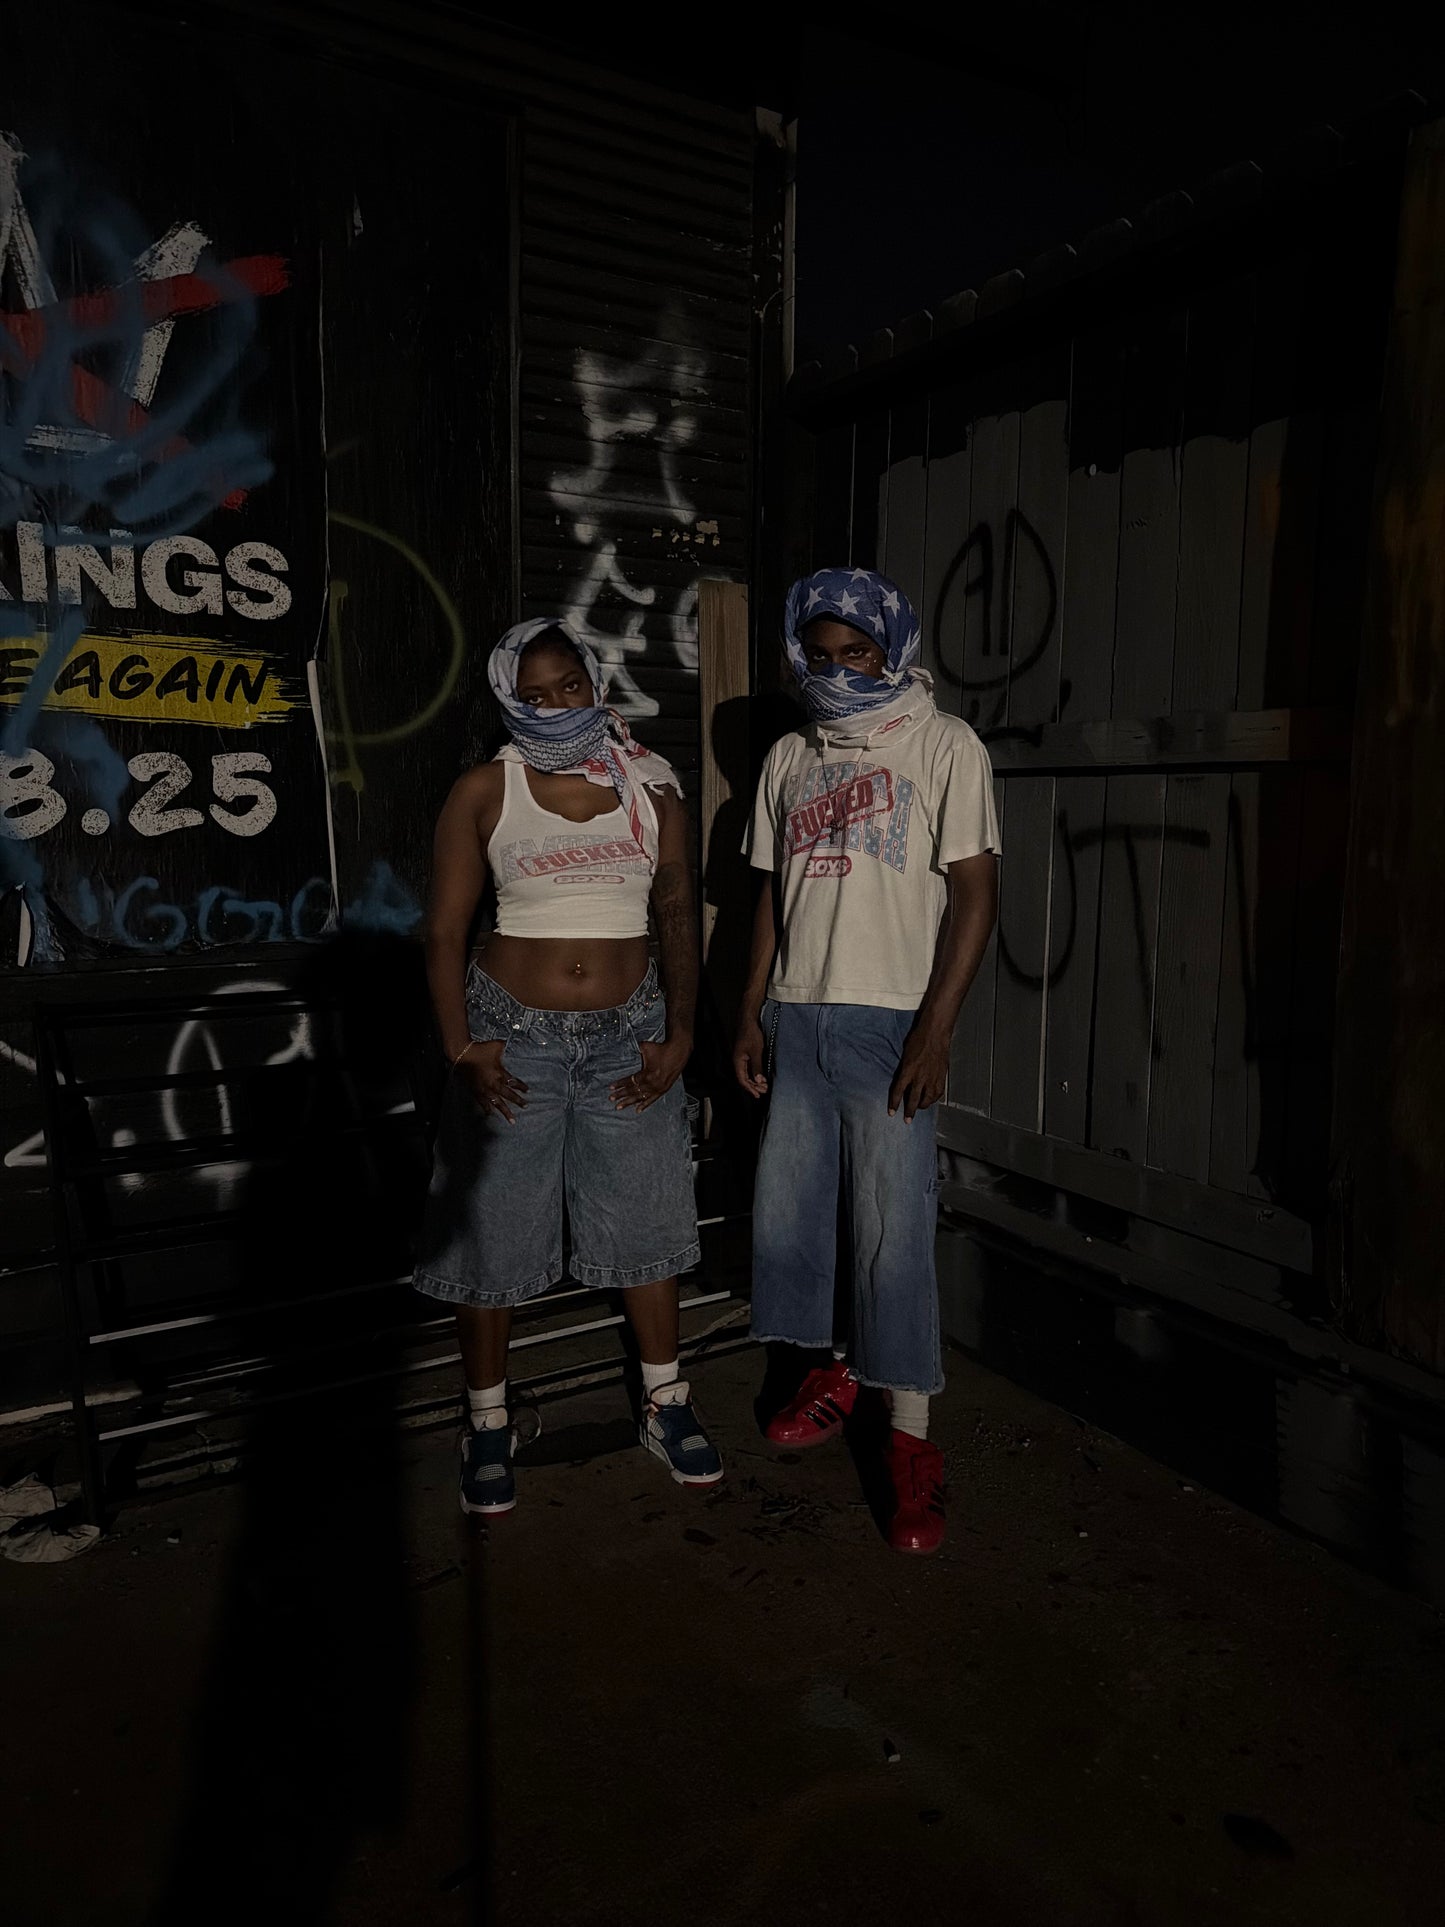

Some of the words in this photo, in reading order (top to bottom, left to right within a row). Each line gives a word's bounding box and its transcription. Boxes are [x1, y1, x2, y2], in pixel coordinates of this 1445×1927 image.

[0, 519, 293, 622] INGS
[54, 648, 270, 706] AGAIN
[788, 777, 875, 844] FUCKED
[530, 840, 640, 872] FUCKED
[805, 857, 850, 876] BOYS
